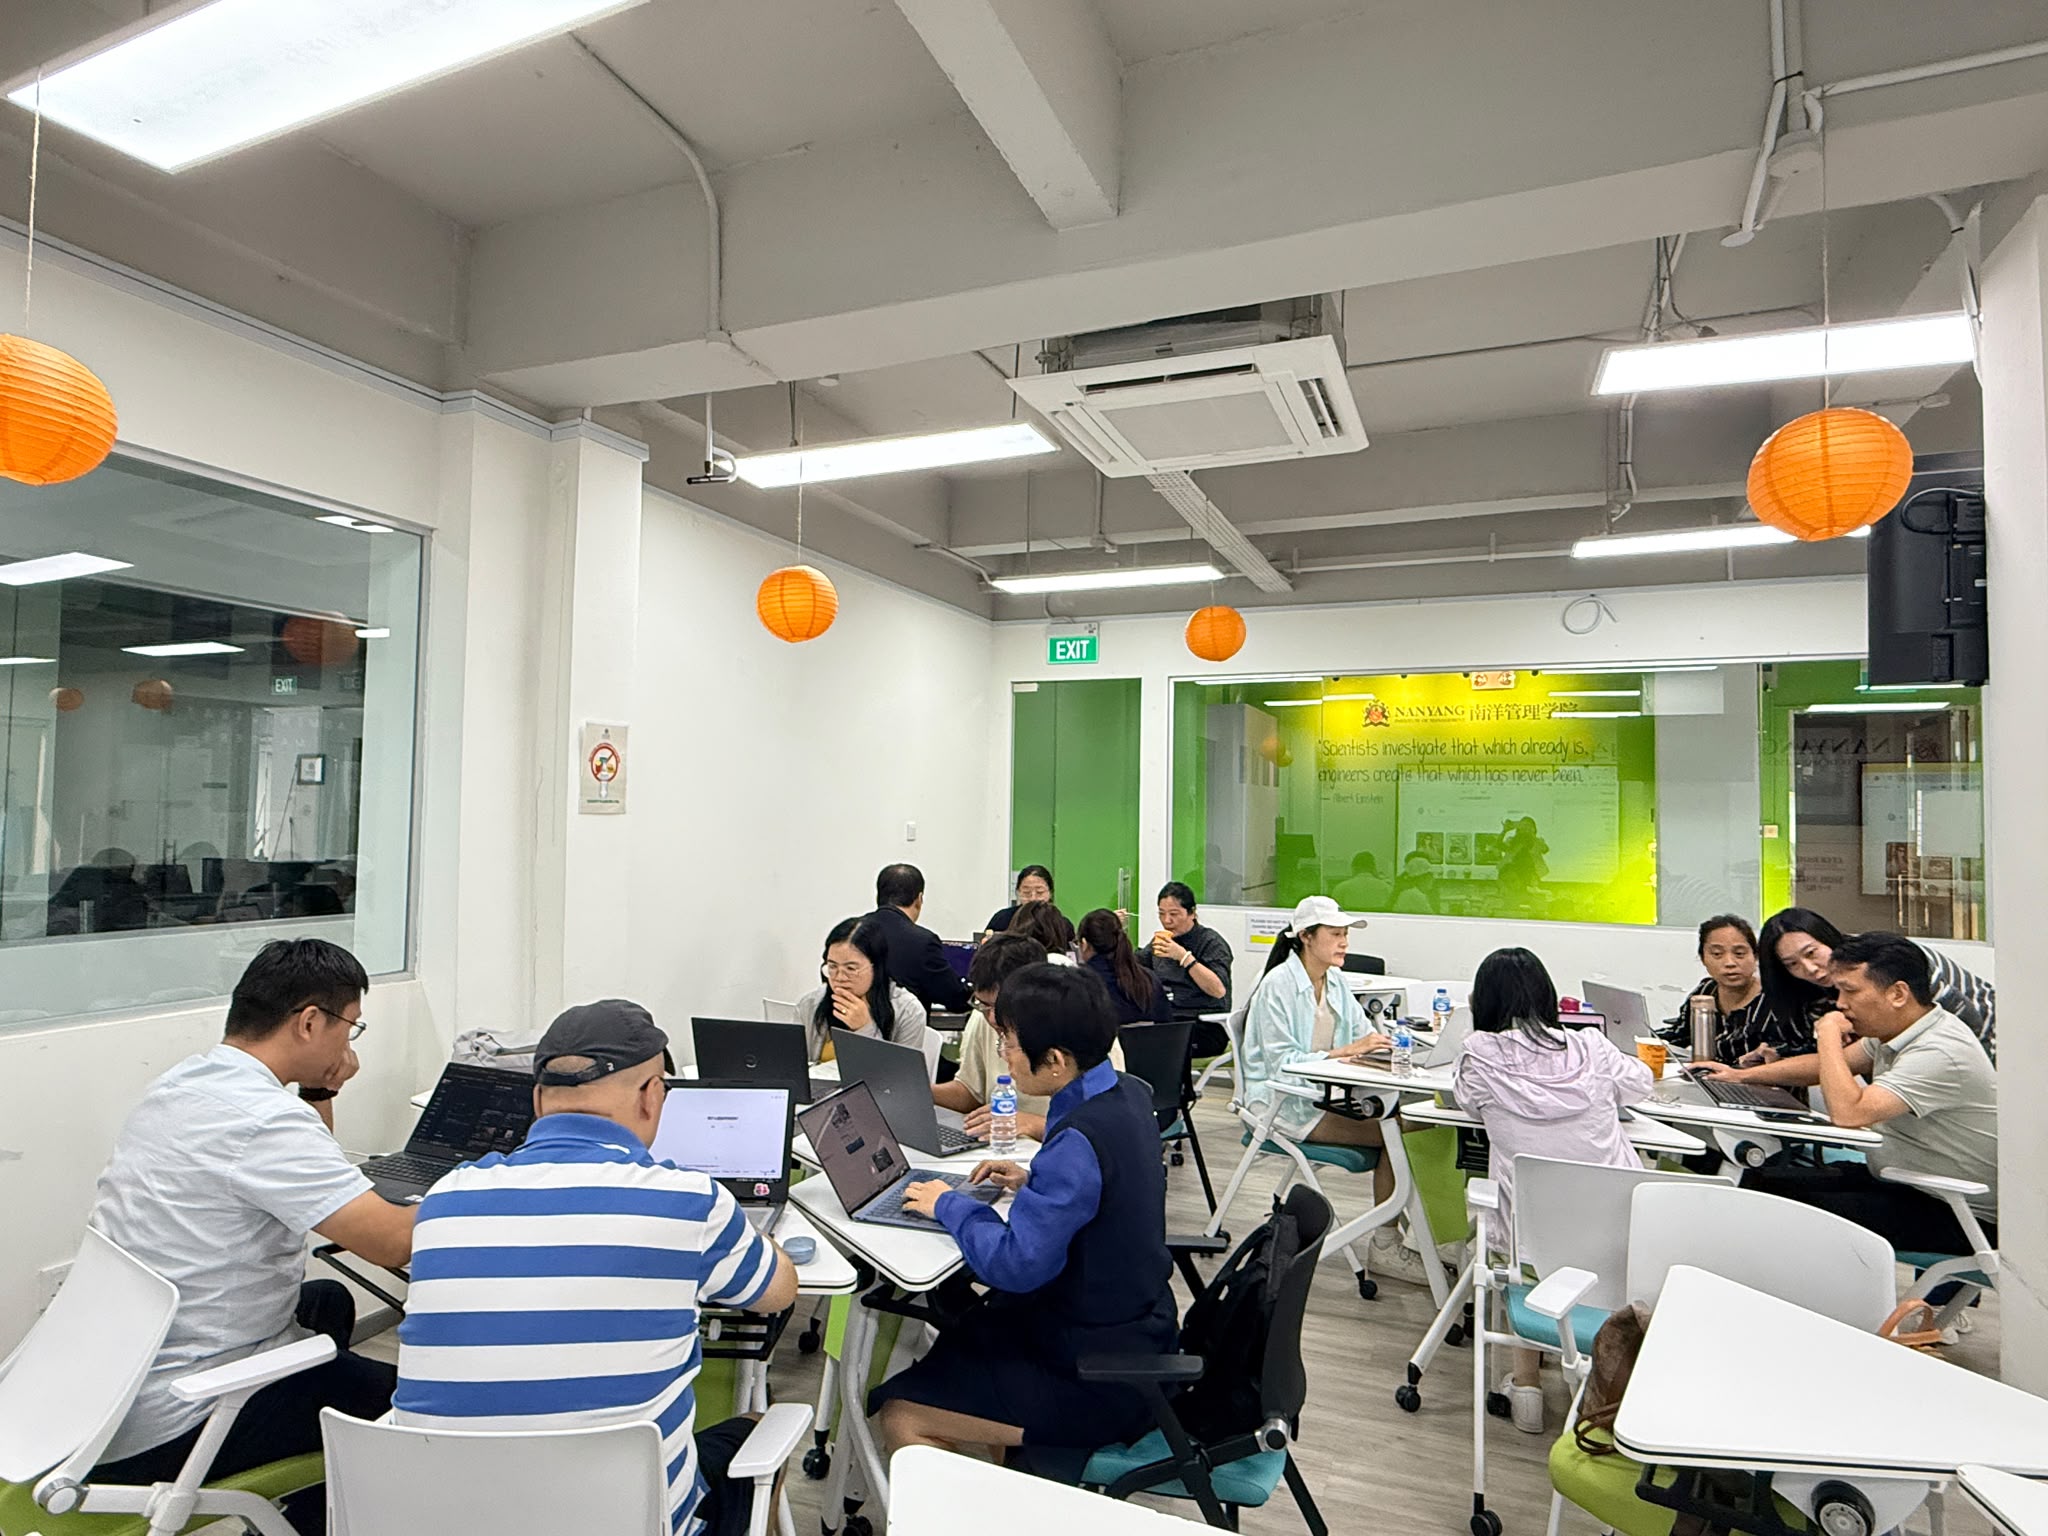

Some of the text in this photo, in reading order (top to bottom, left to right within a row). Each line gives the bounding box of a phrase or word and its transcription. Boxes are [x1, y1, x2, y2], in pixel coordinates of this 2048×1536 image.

[1056, 639, 1090, 660] EXIT
[275, 678, 293, 693] EXIT
[1395, 704, 1465, 718] NANYANG
[1382, 738, 1447, 763] investigate
[1451, 737, 1479, 755] that
[1483, 737, 1517, 755] which
[1521, 736, 1569, 762] already
[1318, 768, 1370, 790] engineers
[1373, 763, 1413, 782] create
[1417, 763, 1443, 782] that
[1447, 764, 1480, 782] which
[1485, 764, 1509, 782] has
[1512, 768, 1548, 782] never
